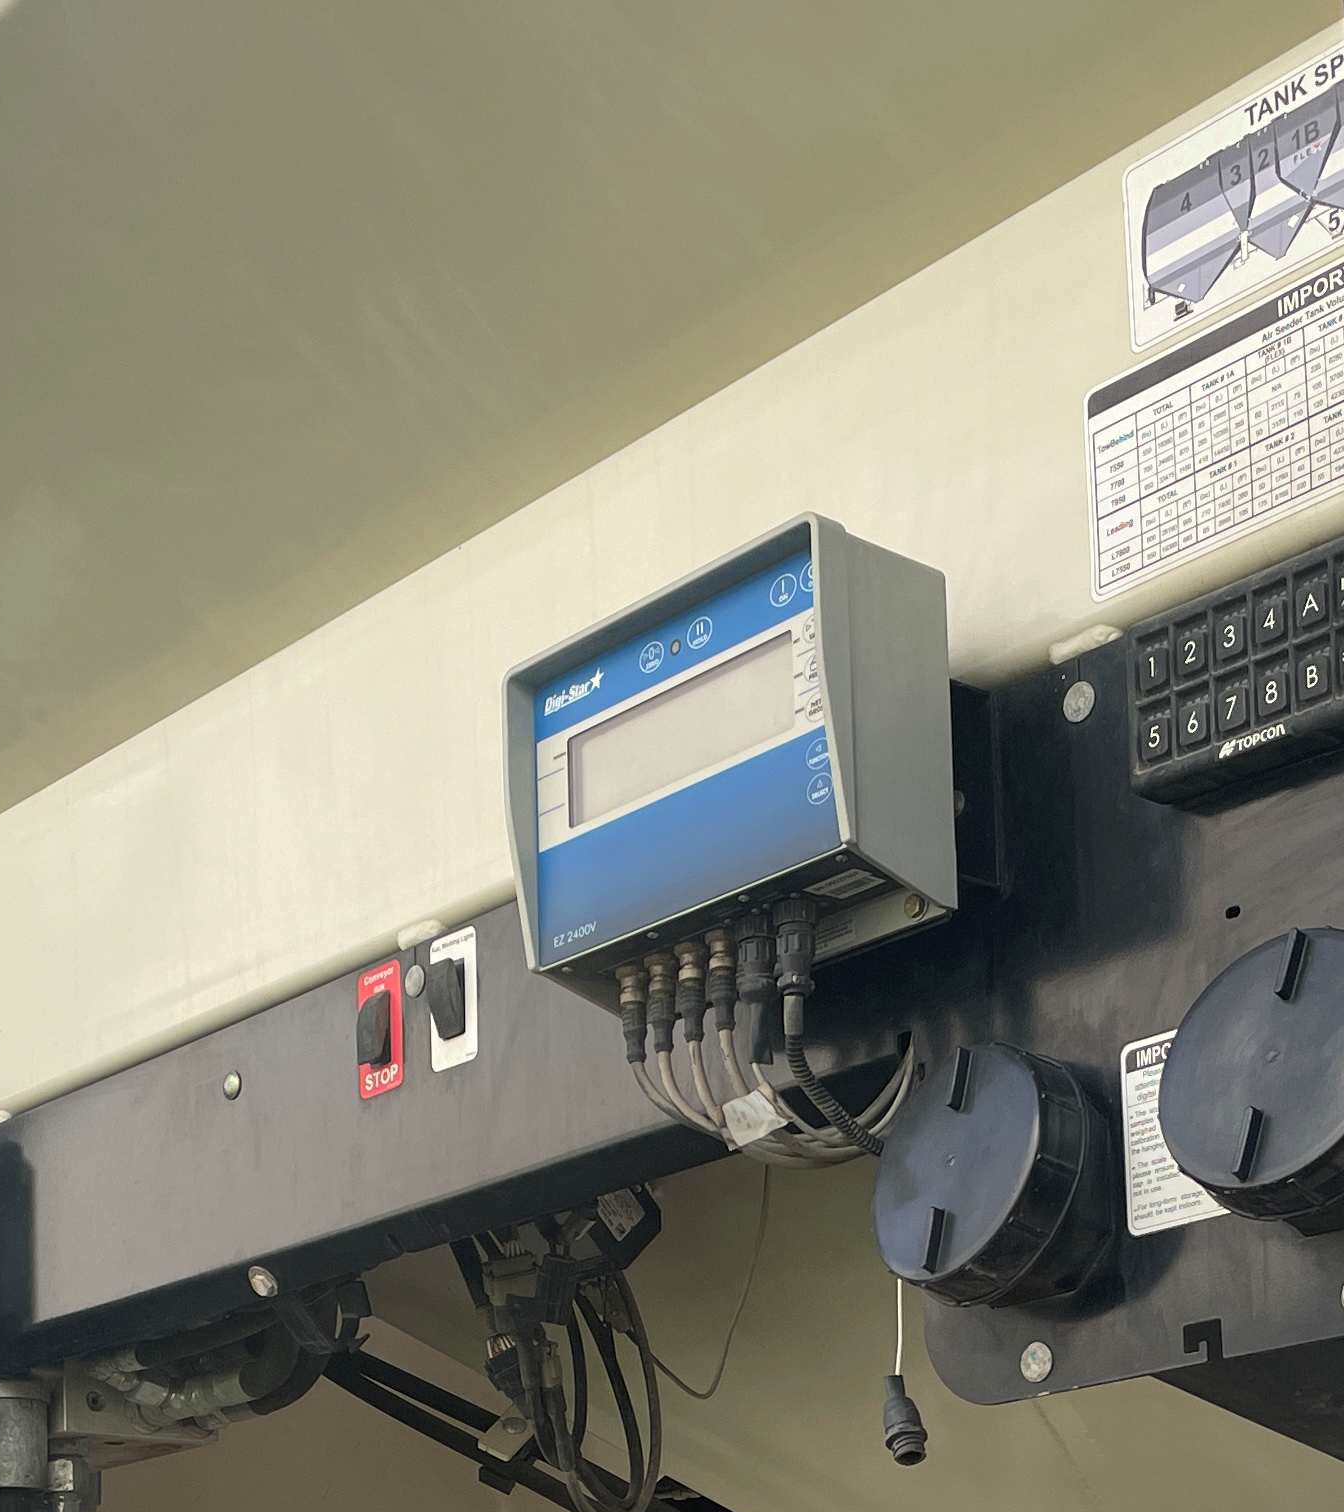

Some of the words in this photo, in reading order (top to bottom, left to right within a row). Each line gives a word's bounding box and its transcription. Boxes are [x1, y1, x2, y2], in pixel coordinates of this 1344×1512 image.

[1244, 75, 1307, 126] TANK
[1315, 55, 1344, 86] SP
[1291, 120, 1319, 150] 1B
[1258, 148, 1270, 172] 2
[1230, 164, 1241, 185] 3
[1180, 192, 1193, 212] 4
[1328, 212, 1340, 232] 5
[1262, 328, 1273, 342] Air
[1275, 314, 1303, 335] Seeder
[1305, 303, 1324, 318] Tank
[1318, 317, 1337, 332] TANK
[1258, 345, 1274, 359] TANK
[1202, 377, 1219, 391] TANK
[1153, 399, 1173, 416] TOTAL
[1323, 408, 1342, 423] TANK
[1265, 437, 1283, 452] TANK
[1209, 464, 1226, 479] TANK
[1157, 488, 1177, 504] TOTAL
[1147, 655, 1157, 679] 1
[1184, 641, 1197, 665] 2
[1223, 625, 1236, 649] 3
[1263, 608, 1276, 631] 4
[1303, 593, 1319, 615] A
[544, 681, 591, 715] Digi-Star
[1148, 725, 1160, 749] 5
[1186, 711, 1198, 734] 6
[1225, 696, 1237, 720] 7
[1265, 681, 1277, 704] 8
[1306, 666, 1318, 689] B
[1236, 724, 1286, 751] TOPCON
[553, 934, 565, 948] EZ
[567, 922, 597, 944] 2400V
[364, 967, 394, 986] Conveyor
[365, 1064, 398, 1091] STOP
